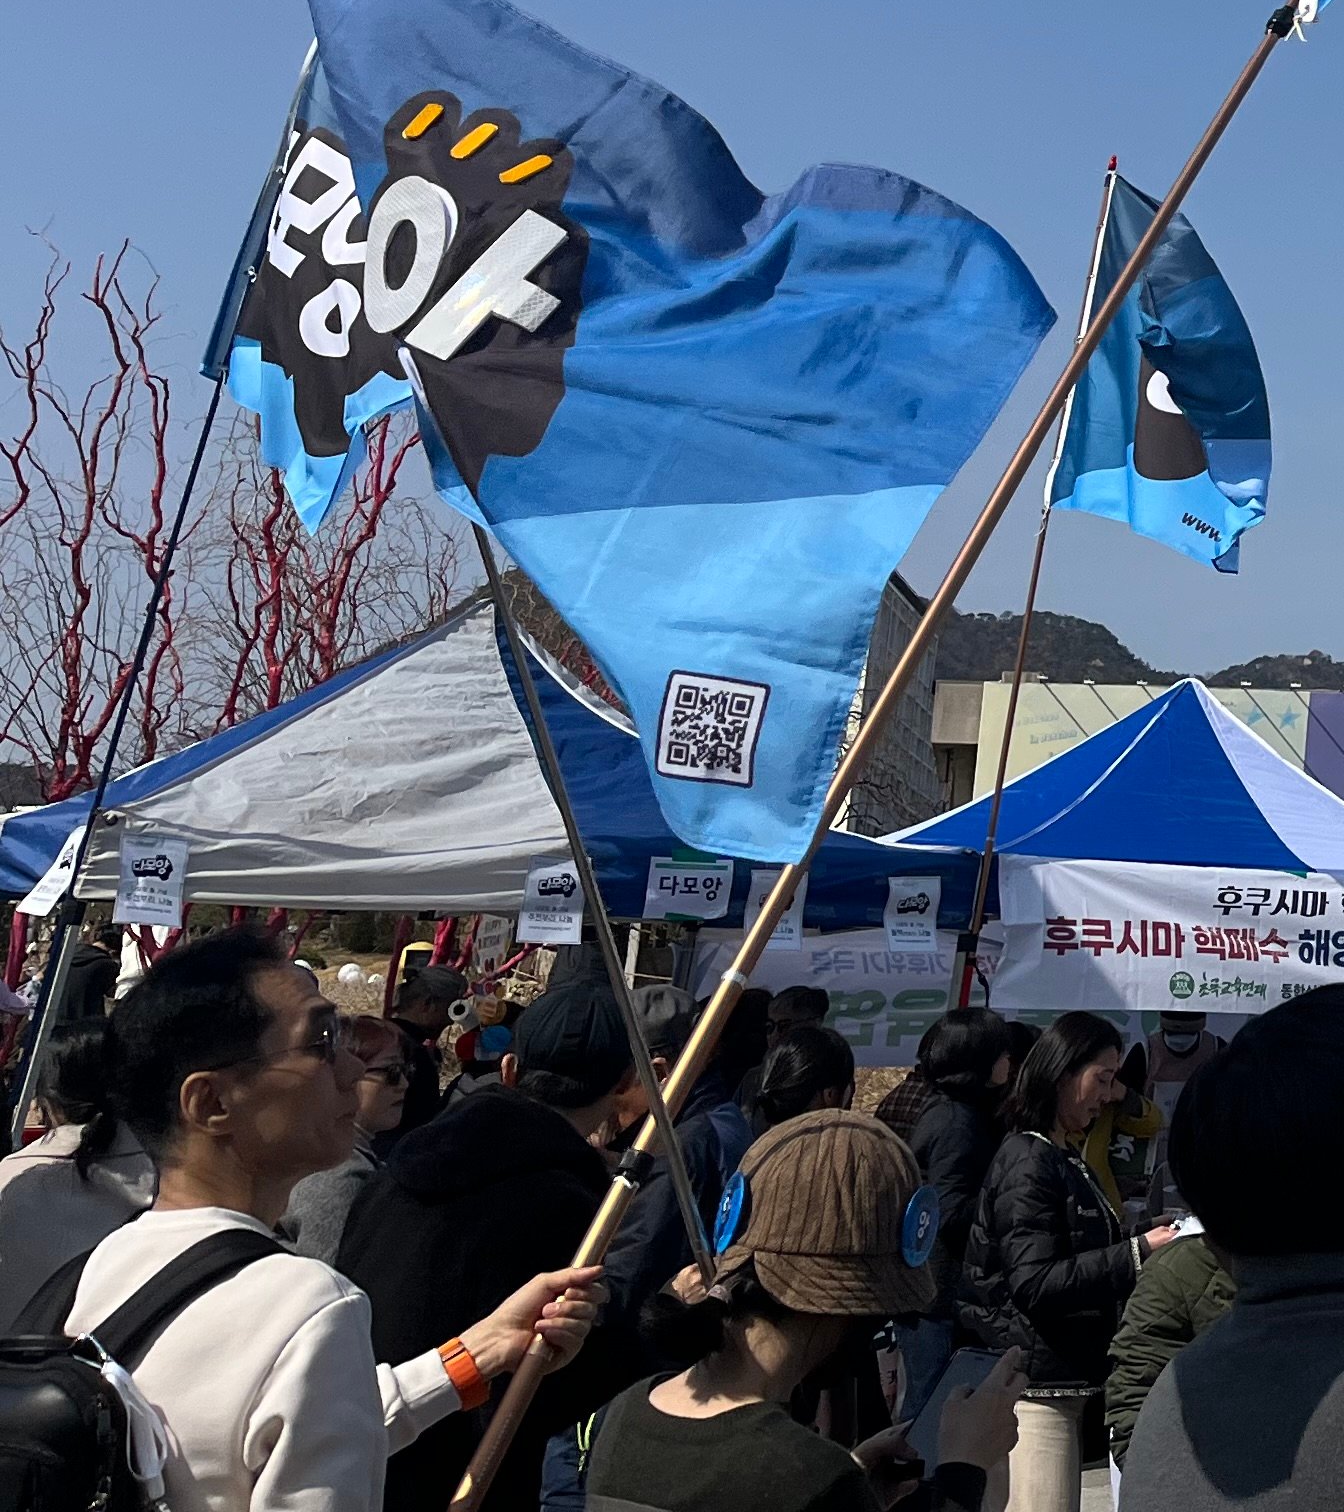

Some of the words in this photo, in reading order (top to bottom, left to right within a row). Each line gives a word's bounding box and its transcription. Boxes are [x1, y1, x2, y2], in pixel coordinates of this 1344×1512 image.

[659, 875, 723, 901] 다모앙
[1213, 885, 1329, 918] 후쿠시마
[1043, 916, 1185, 959] 후쿠시마
[1194, 925, 1290, 964] 핵폐수
